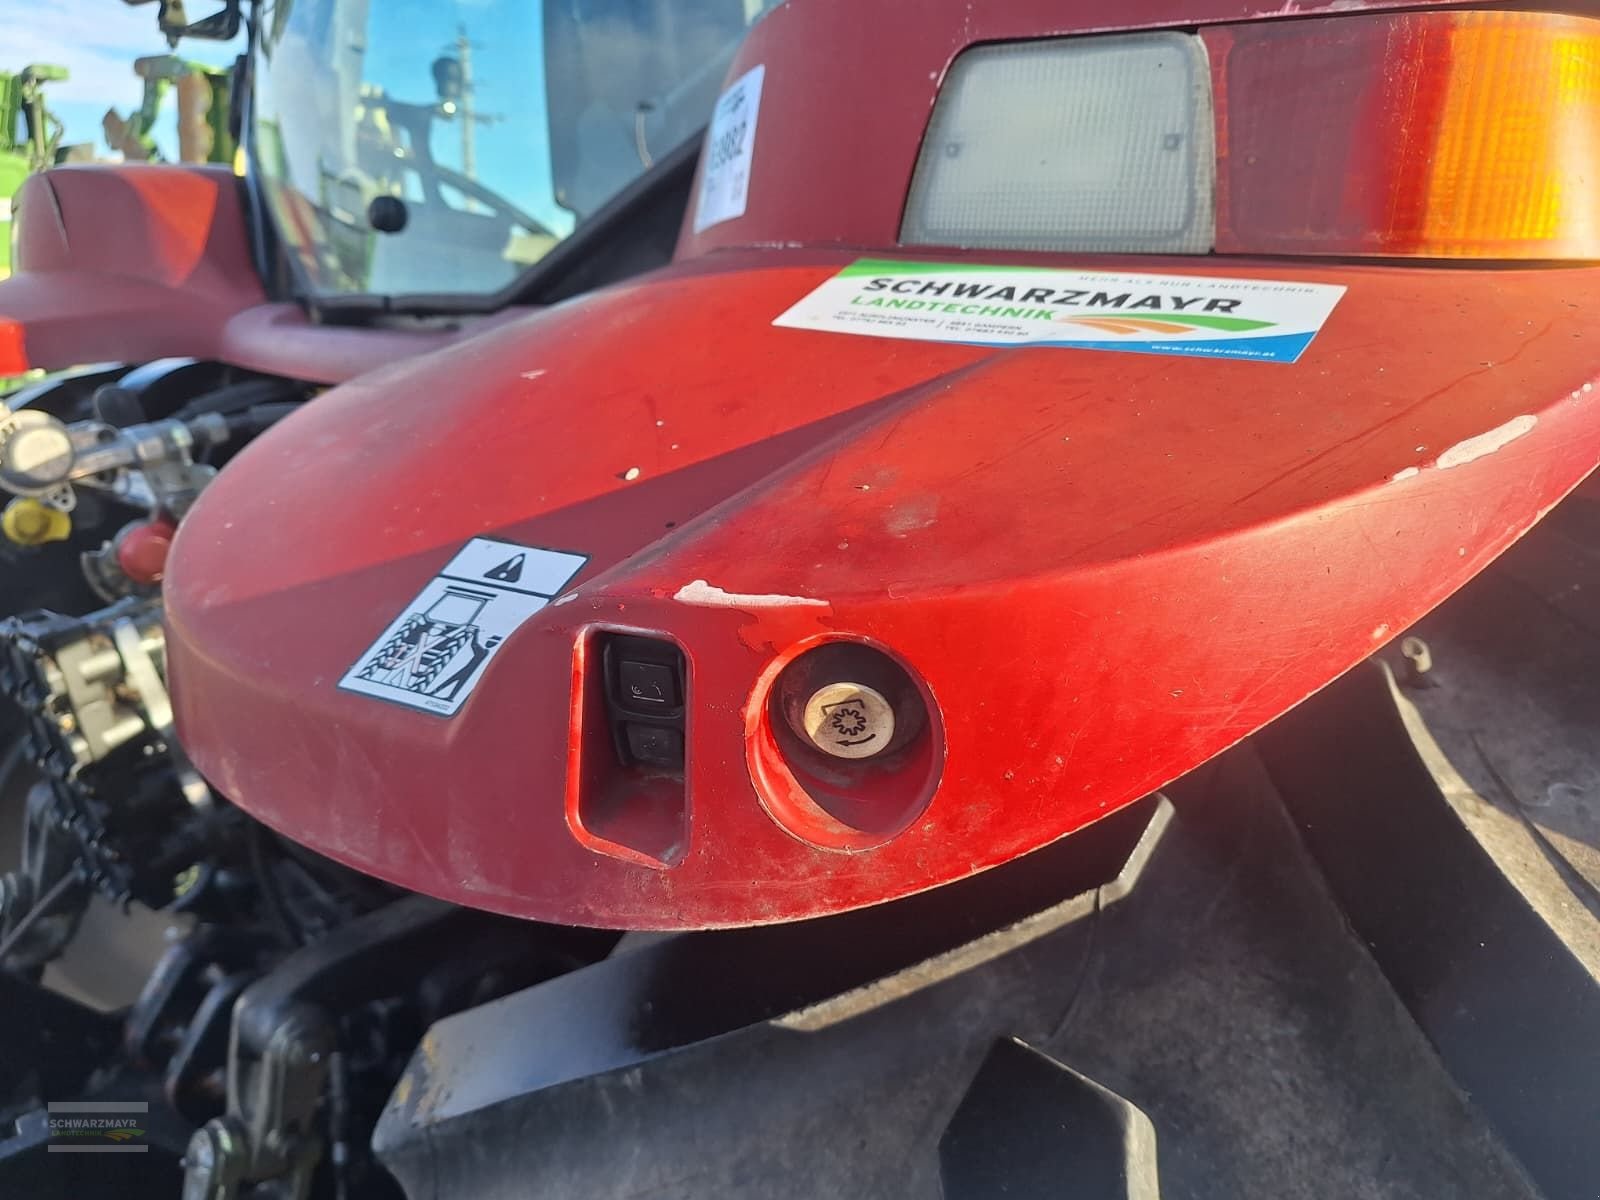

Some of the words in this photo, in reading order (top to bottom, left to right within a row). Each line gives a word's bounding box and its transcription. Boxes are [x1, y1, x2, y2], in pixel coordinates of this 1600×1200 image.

[850, 295, 1057, 321] LANDTECHNIK
[862, 277, 1242, 313] SCHWARZMAYR
[1151, 344, 1276, 358] www.schwarzmayr.at
